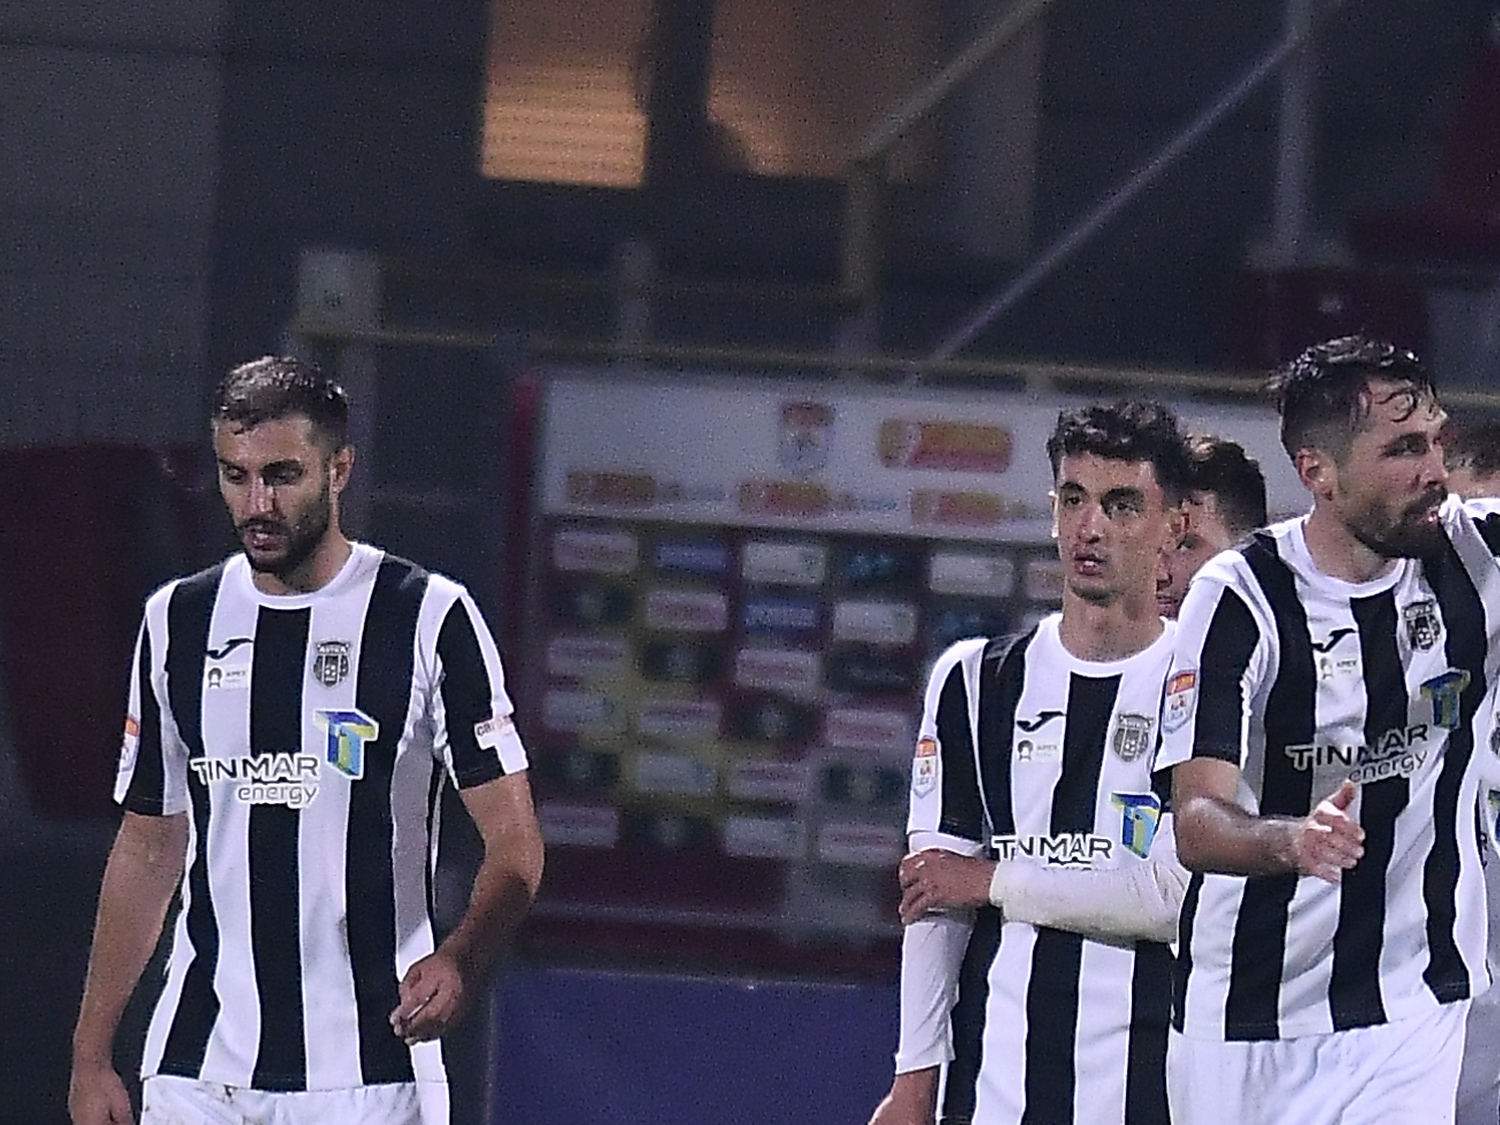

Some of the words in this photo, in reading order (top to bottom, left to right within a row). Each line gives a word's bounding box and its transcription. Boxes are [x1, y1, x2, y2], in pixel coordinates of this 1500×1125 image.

[1286, 723, 1429, 769] TINMAR
[191, 755, 319, 782] TINMAR
[1348, 750, 1429, 783] energy
[237, 785, 318, 806] energy
[993, 835, 1113, 861] TNMAR
